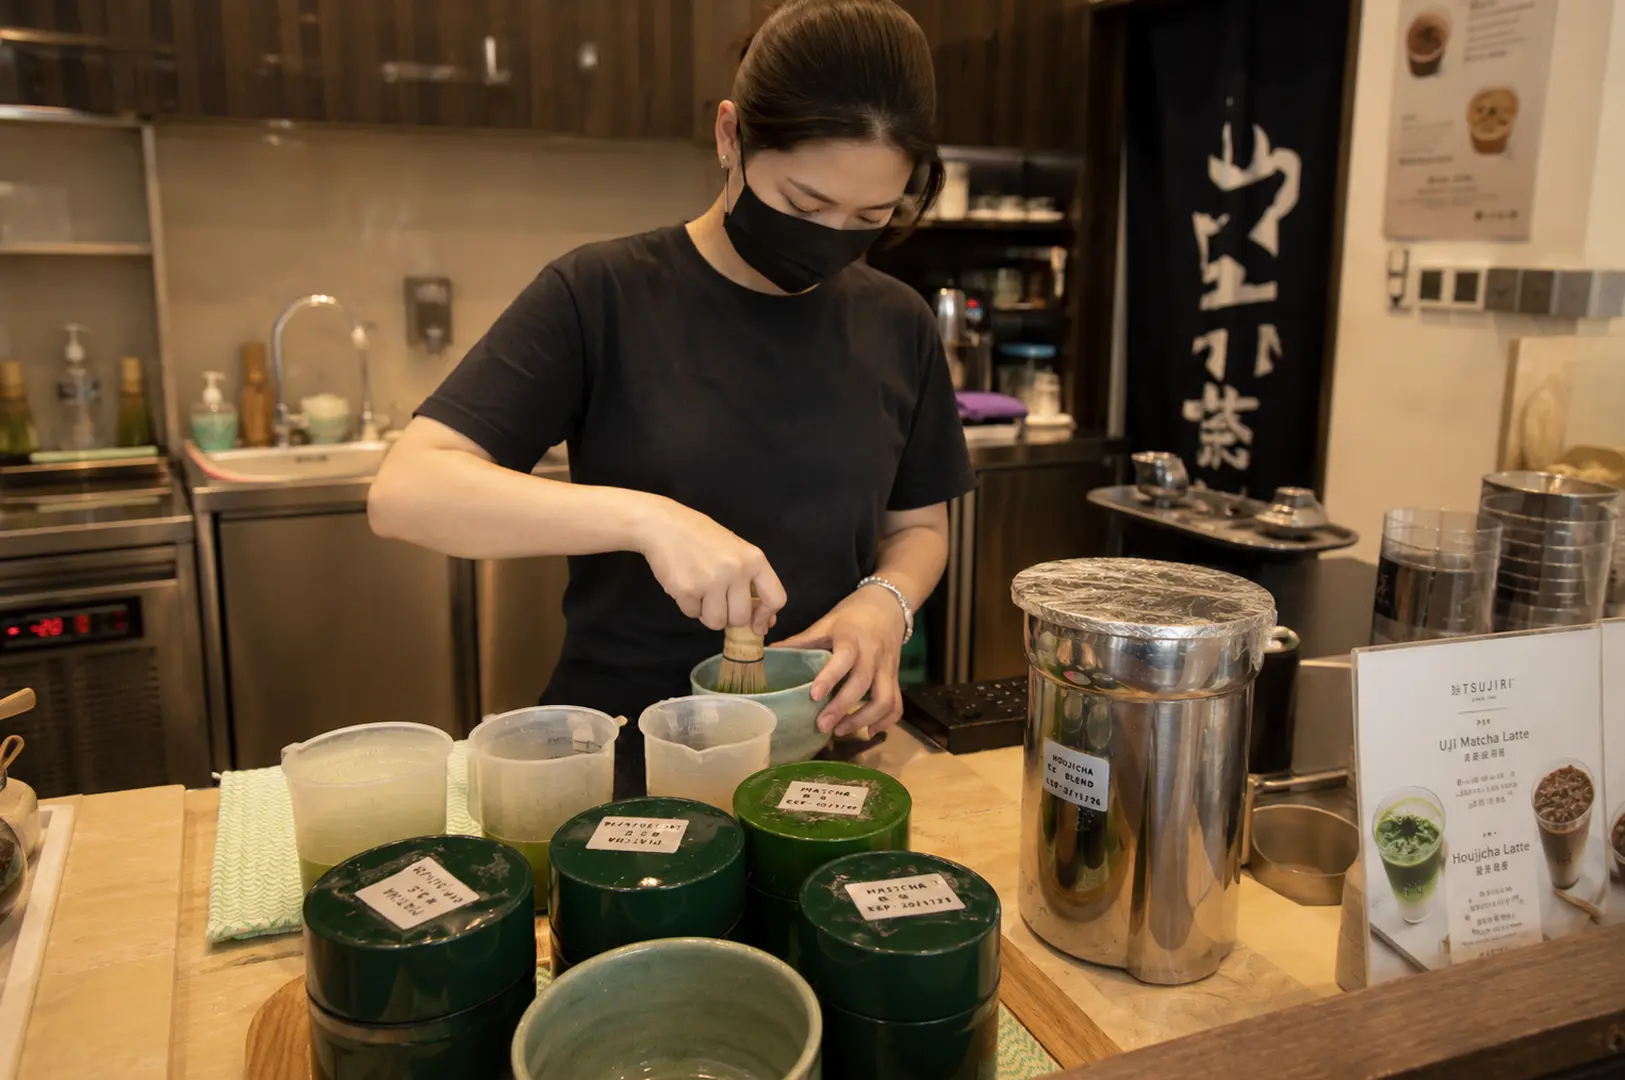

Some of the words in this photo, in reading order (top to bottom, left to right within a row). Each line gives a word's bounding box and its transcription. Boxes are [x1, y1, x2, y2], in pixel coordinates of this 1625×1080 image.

[1462, 678, 1512, 695] TSUJIRI
[1460, 733, 1500, 748] Matcha
[1502, 730, 1530, 742] Latte
[1503, 842, 1531, 856] Latte
